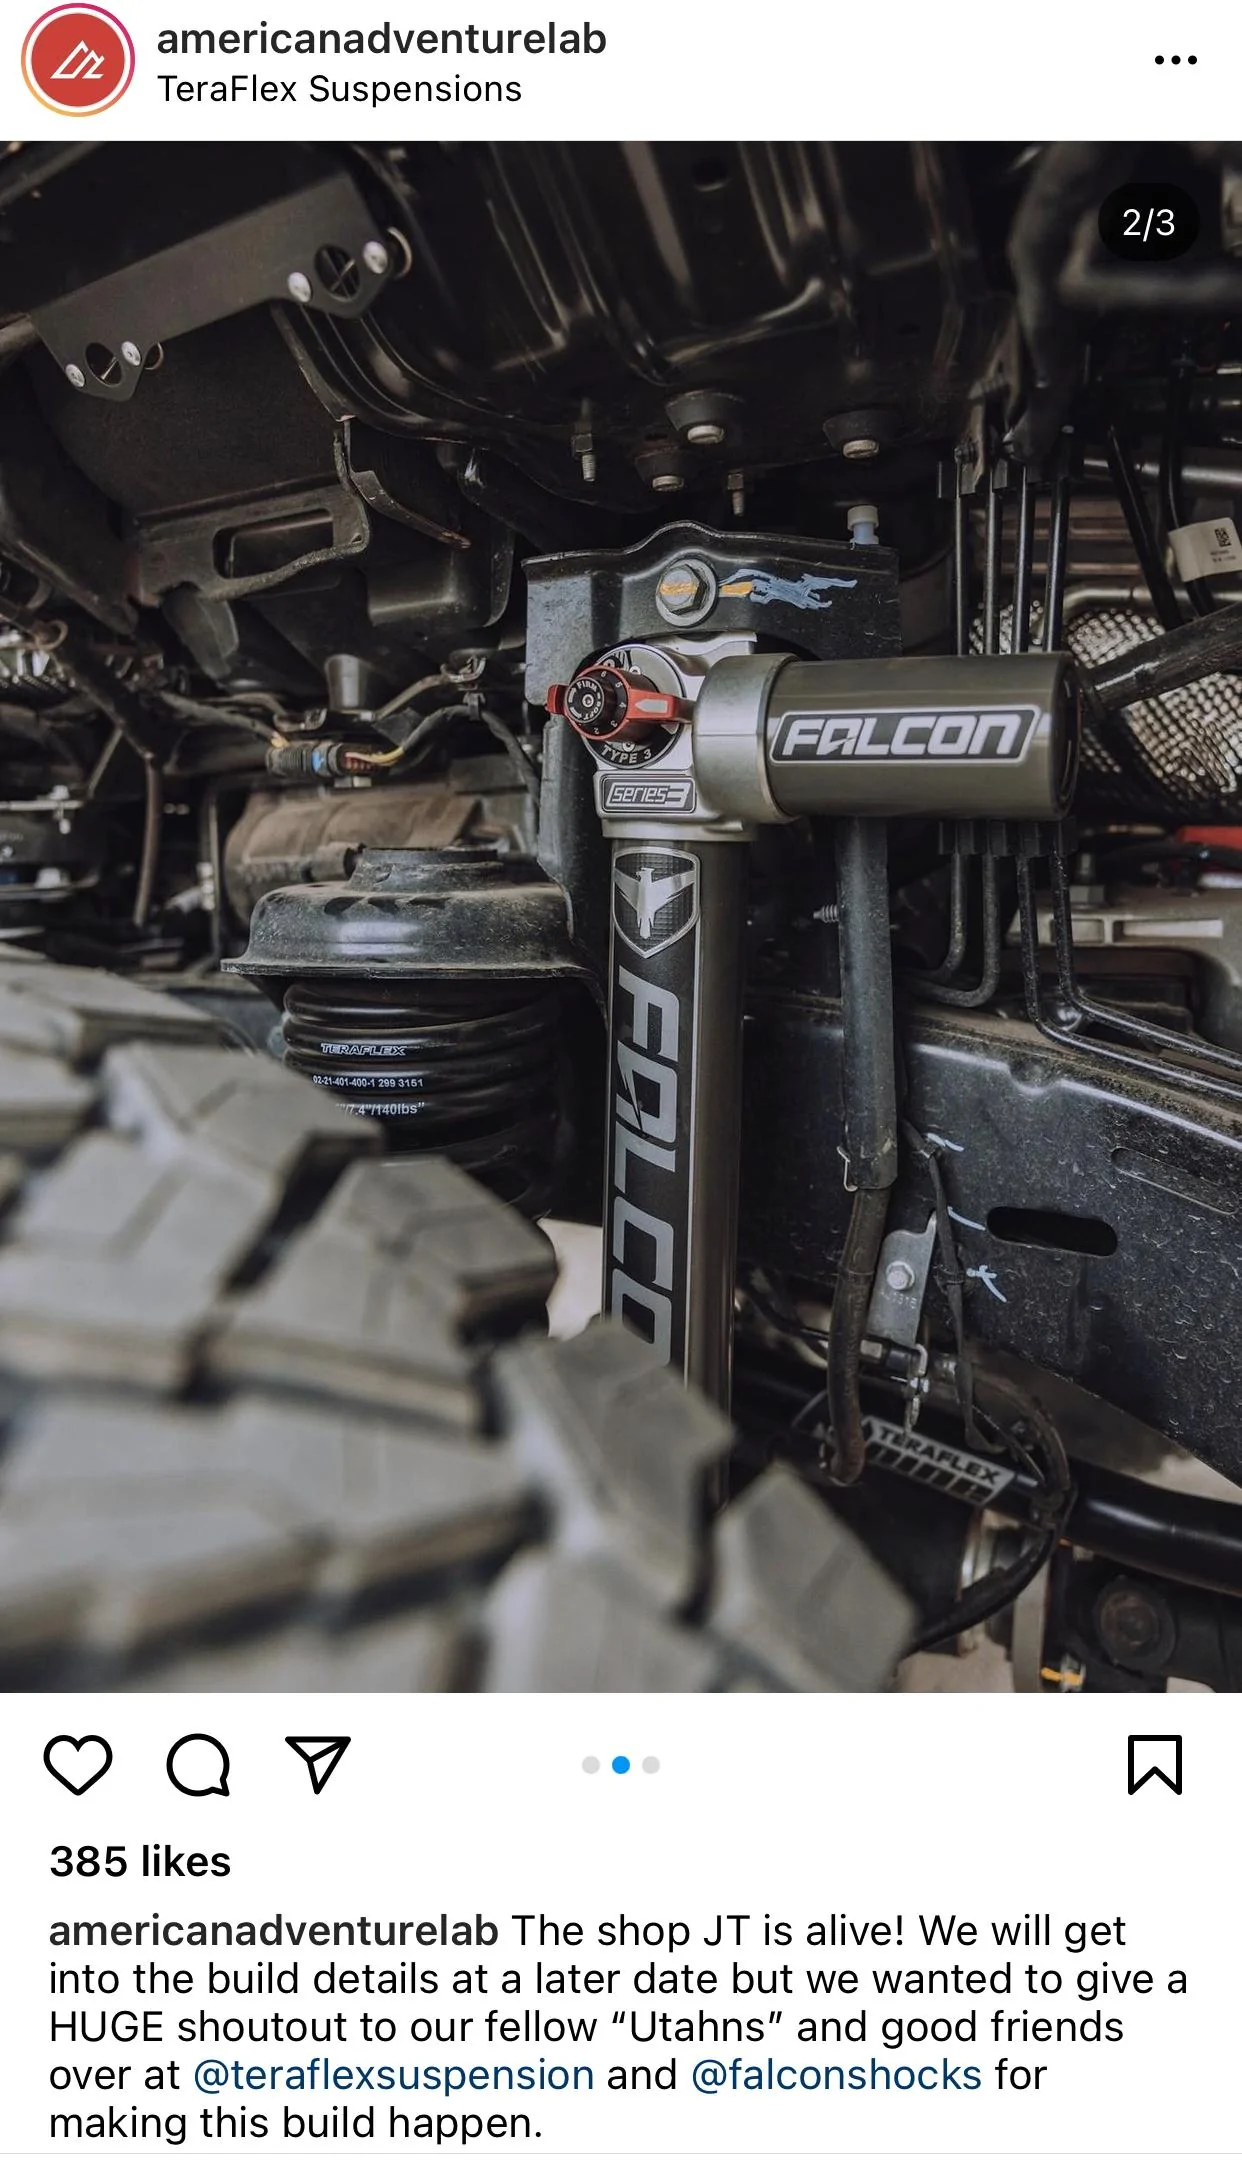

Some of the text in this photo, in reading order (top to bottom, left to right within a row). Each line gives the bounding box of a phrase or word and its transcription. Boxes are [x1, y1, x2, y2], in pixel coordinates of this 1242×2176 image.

[782, 714, 1022, 756] FALCON
[601, 744, 651, 764] TYPE 3
[320, 1042, 407, 1056] TERAFLEX
[378, 1079, 396, 1088] 299
[879, 1426, 999, 1486] TERAFLEX
